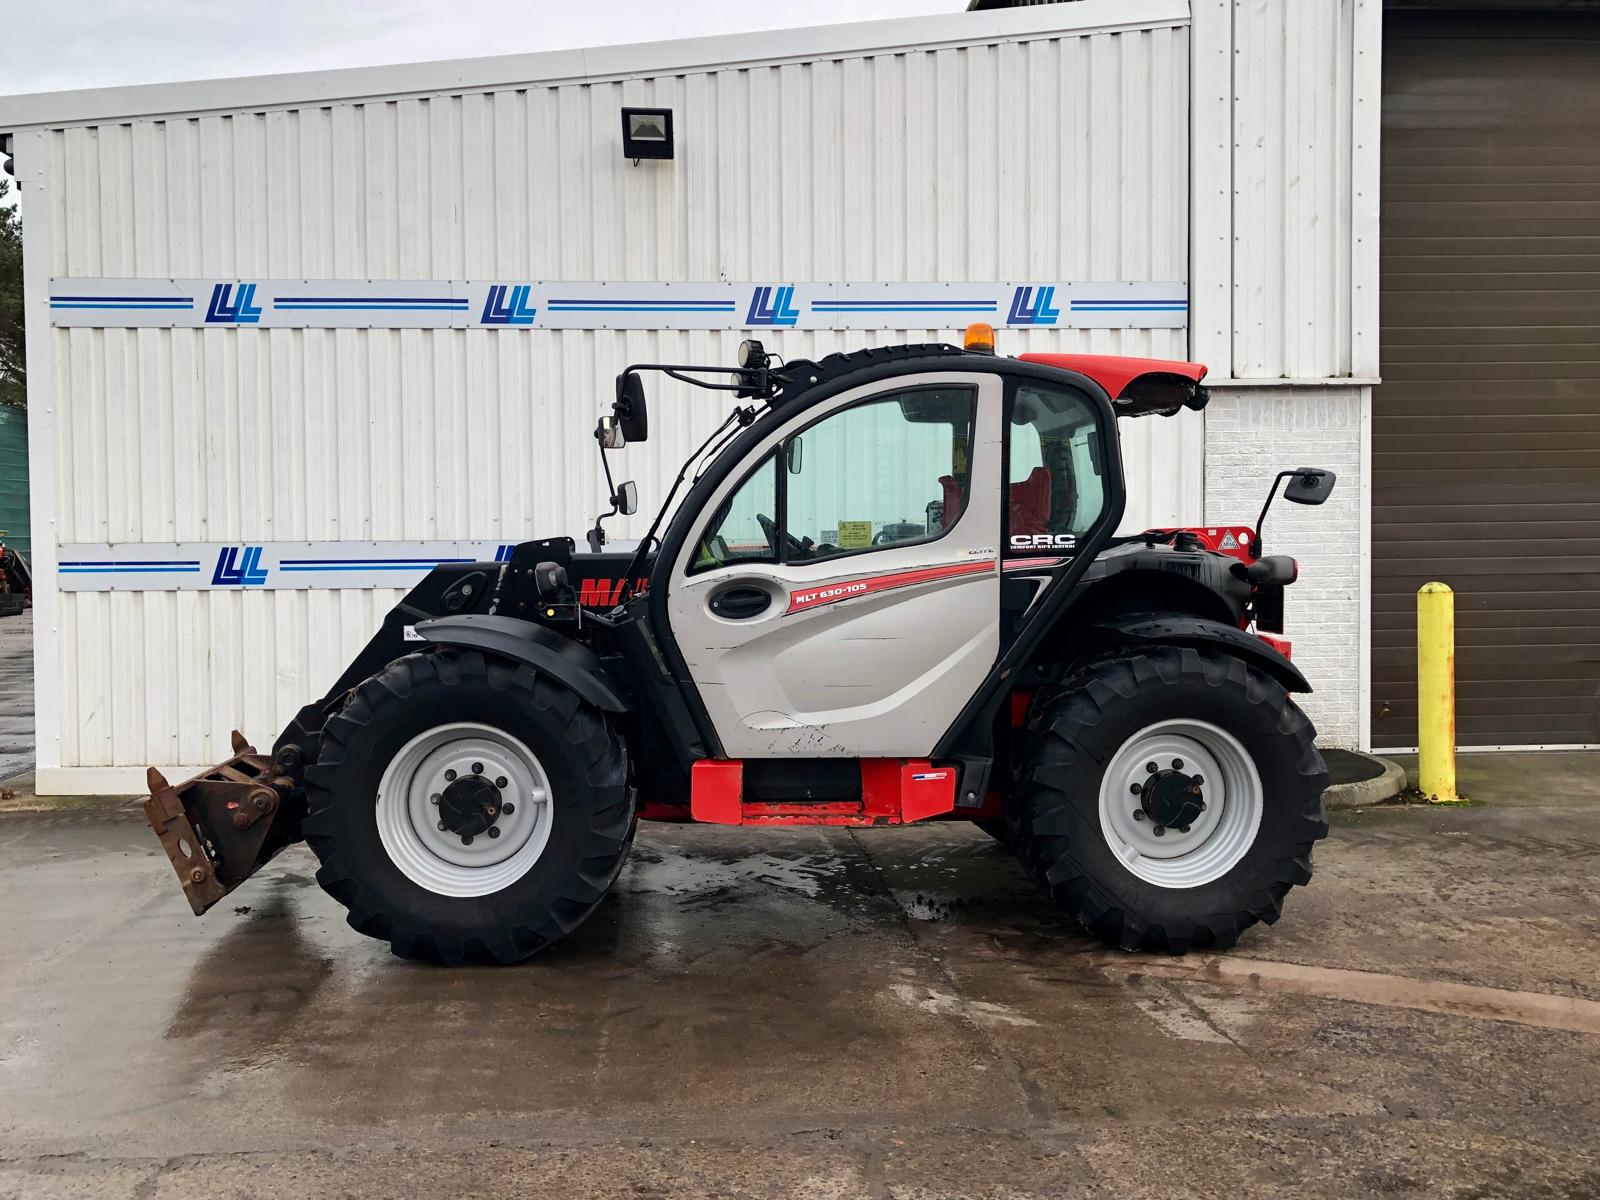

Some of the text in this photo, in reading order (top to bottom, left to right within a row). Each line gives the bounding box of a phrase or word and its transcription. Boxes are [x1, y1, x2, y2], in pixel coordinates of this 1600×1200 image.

[1010, 534, 1076, 545] CRC
[796, 583, 867, 604] MLT 630-105
